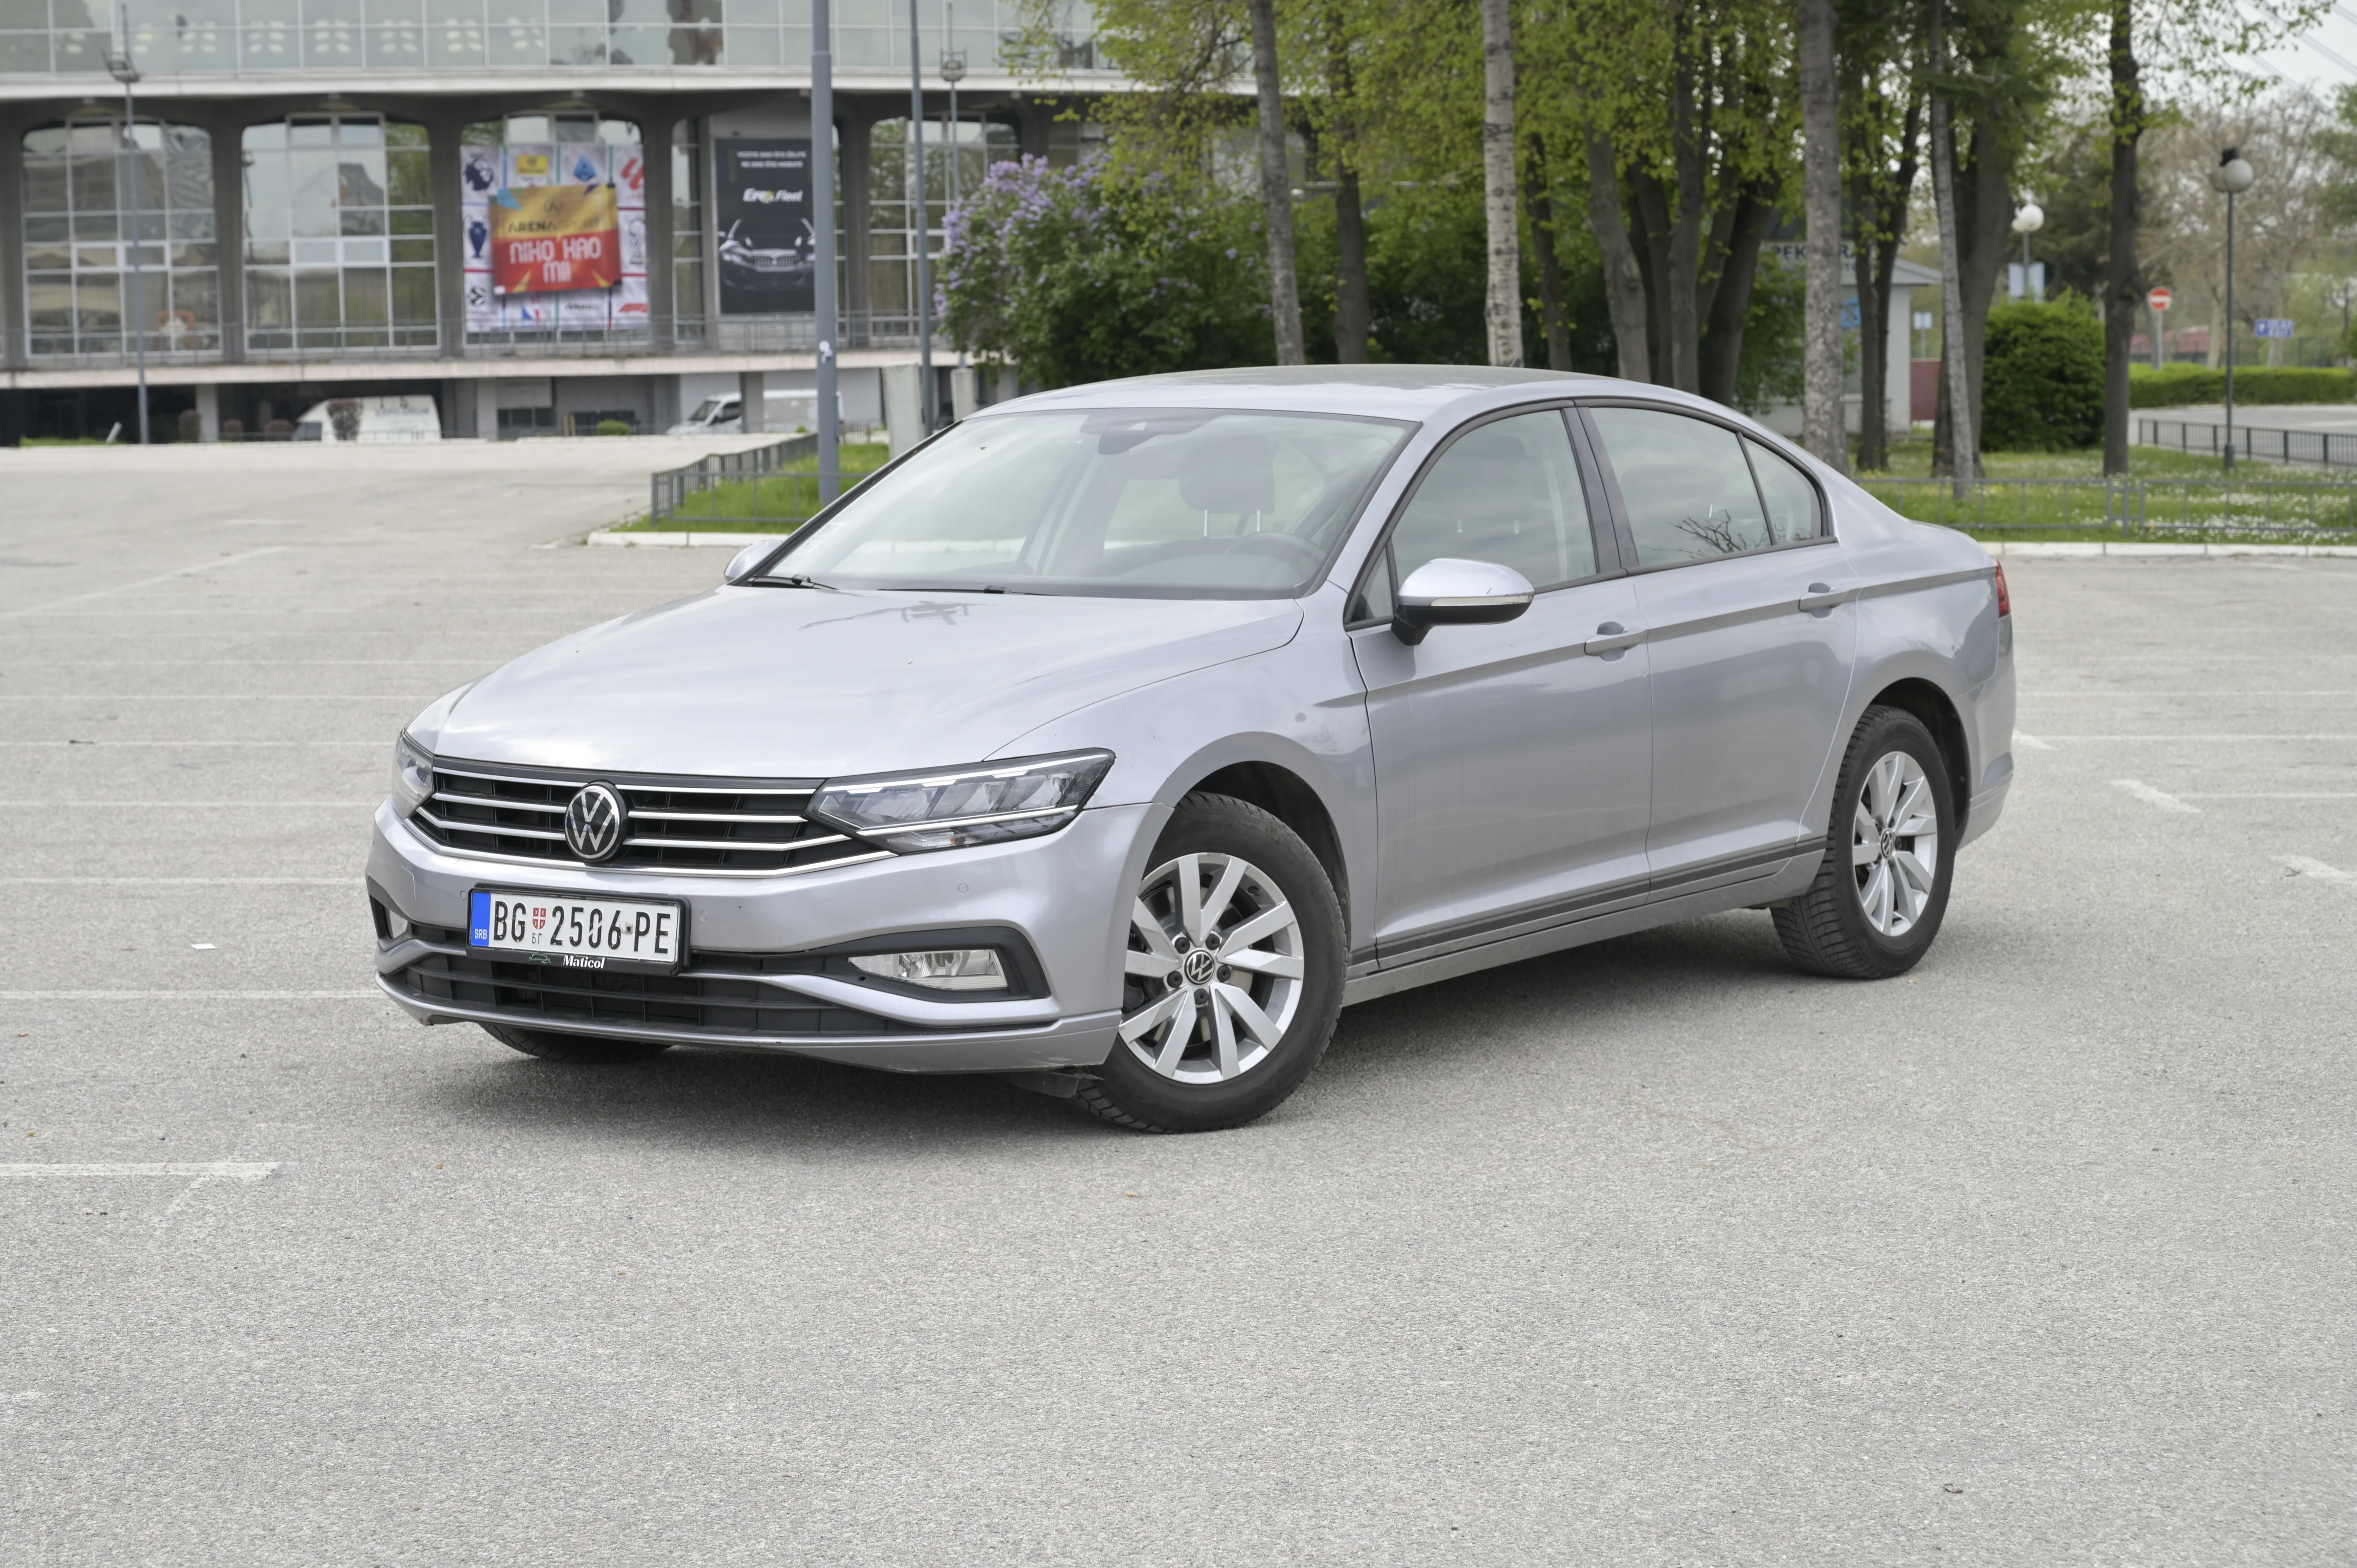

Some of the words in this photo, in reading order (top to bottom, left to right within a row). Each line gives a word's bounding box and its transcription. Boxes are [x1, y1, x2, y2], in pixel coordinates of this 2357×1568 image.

[775, 190, 803, 202] Fleet
[562, 237, 601, 260] KAO
[474, 929, 488, 940] SRB
[493, 901, 527, 942] BG
[634, 911, 671, 954] PE
[563, 954, 605, 969] Maticol
